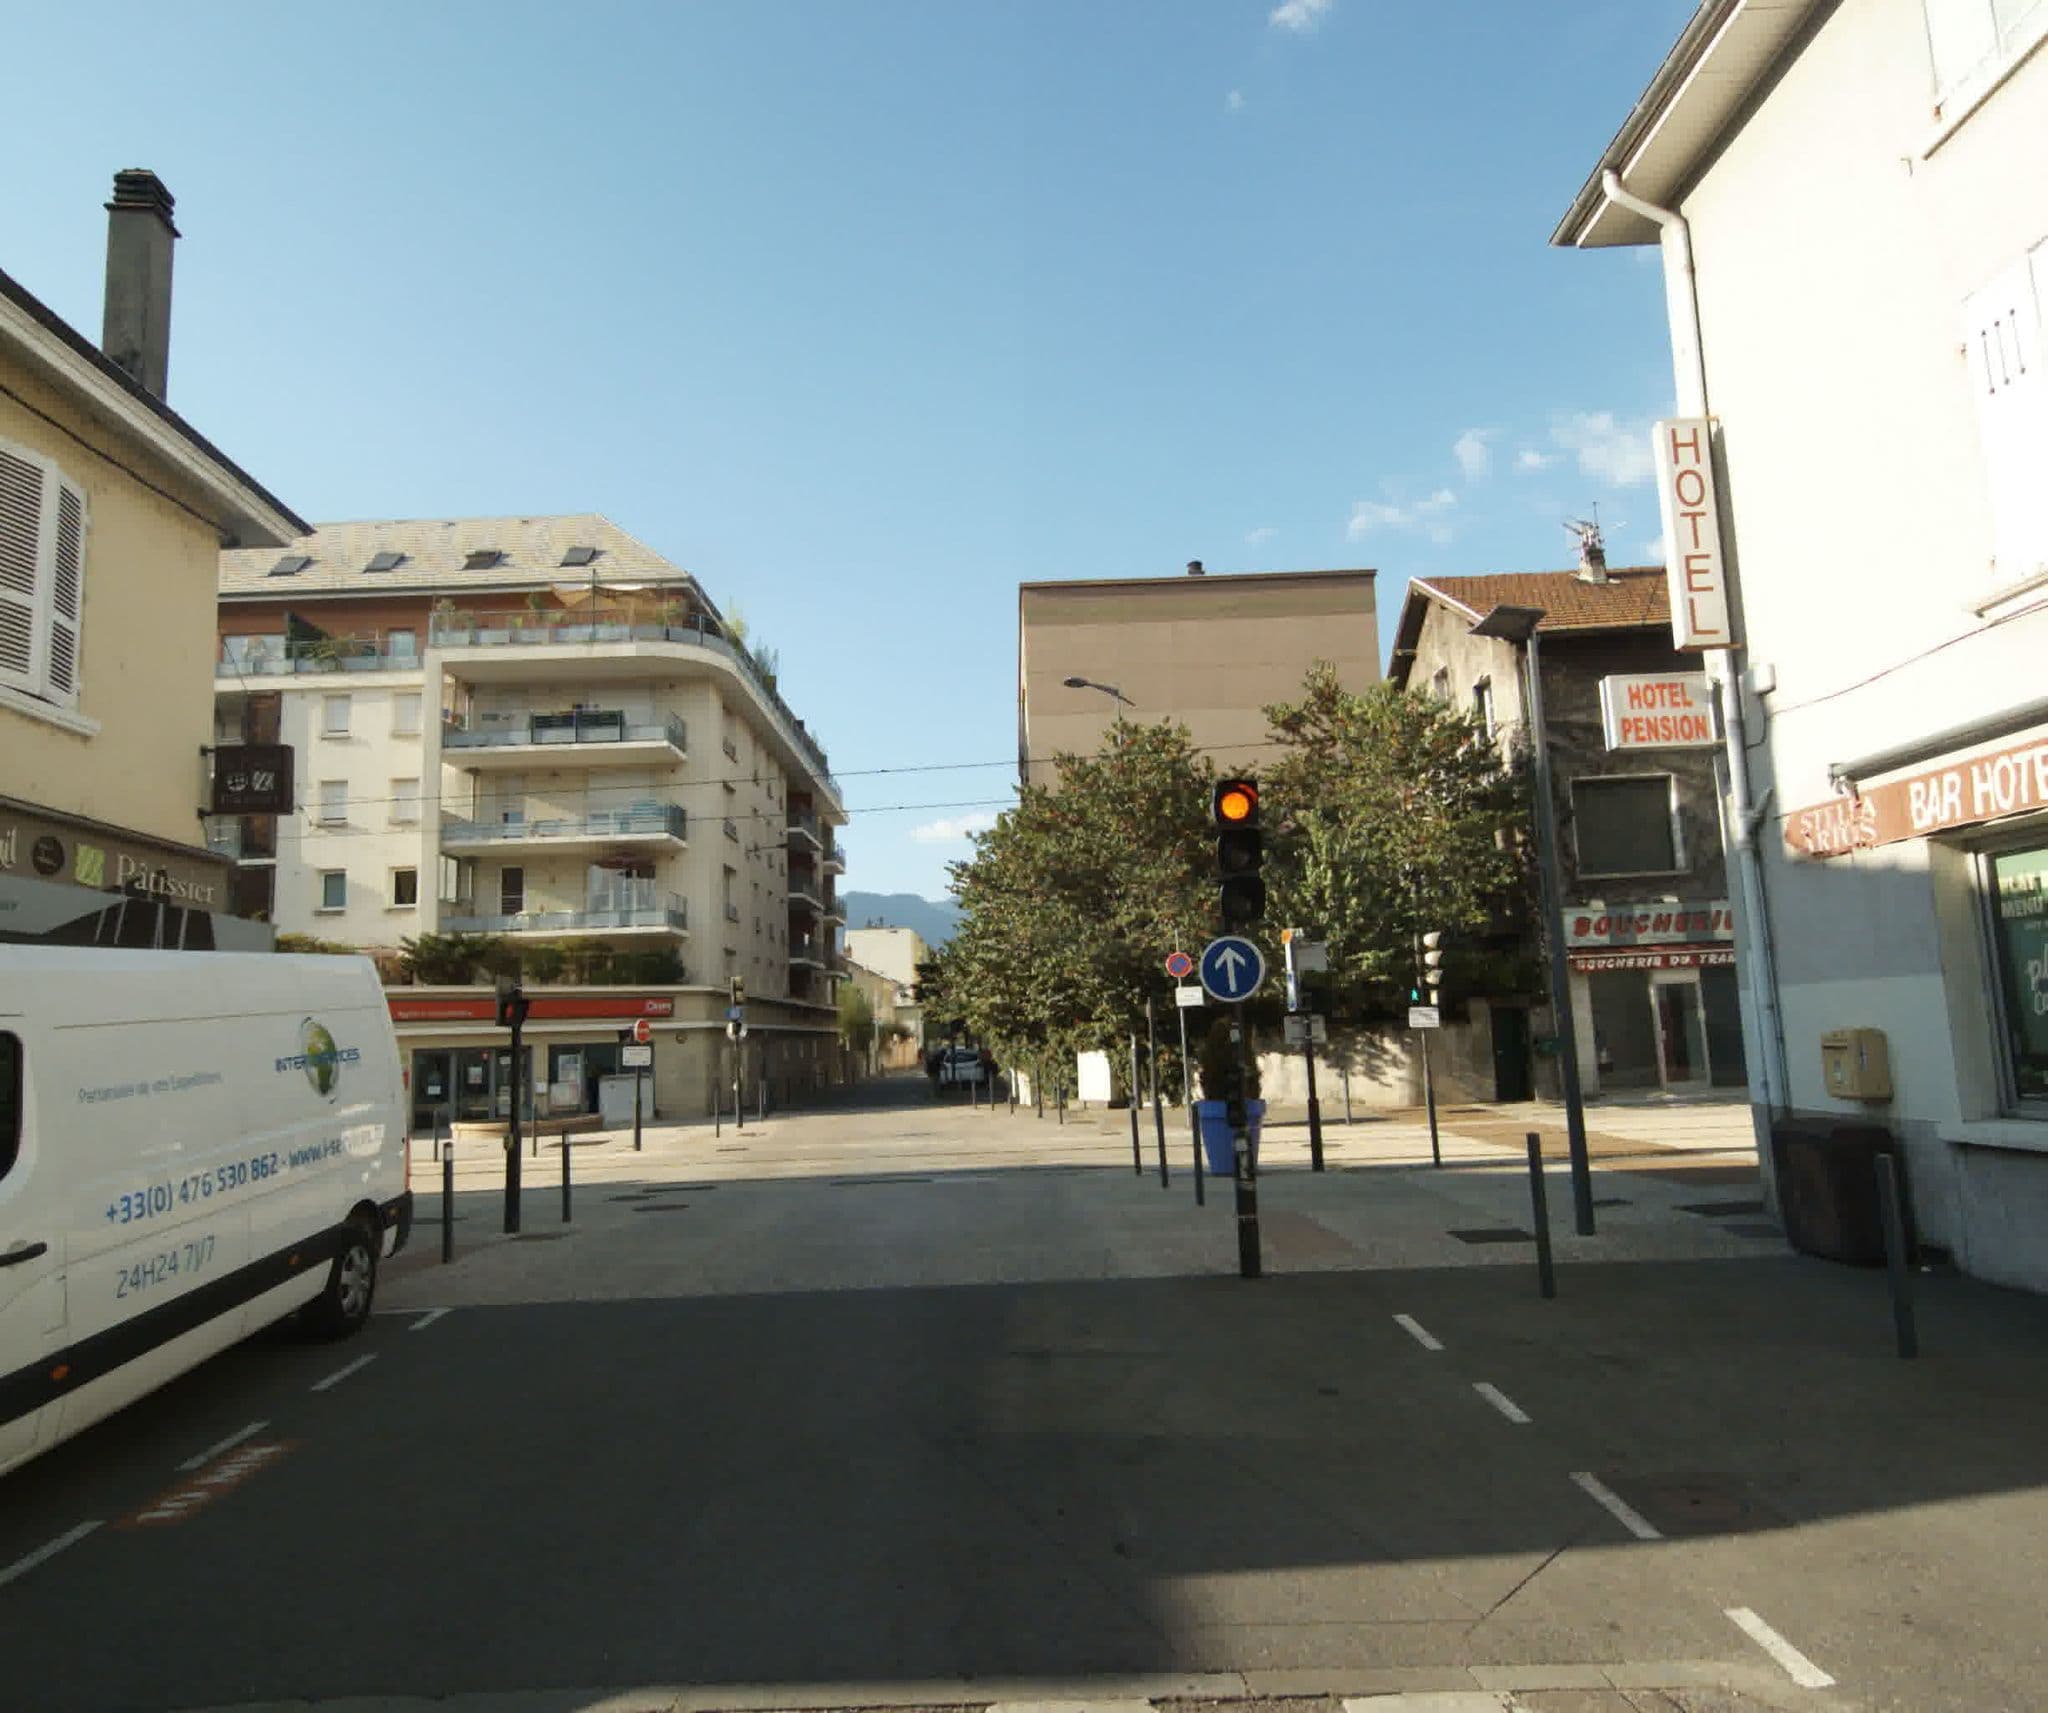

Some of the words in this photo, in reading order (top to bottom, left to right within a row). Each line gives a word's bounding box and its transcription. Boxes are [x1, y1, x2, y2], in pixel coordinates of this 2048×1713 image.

[1671, 427, 1720, 635] HOTEL
[1627, 682, 1694, 709] HOTEL
[1620, 714, 1708, 743] PENSION
[1908, 771, 1962, 830] BAR
[1576, 956, 1662, 970] BOUCHERIE
[106, 1180, 173, 1224] +33(0)
[178, 1171, 213, 1203] 476
[216, 1163, 247, 1192] 530
[251, 1152, 278, 1180] 862
[116, 1250, 179, 1299] 24H24
